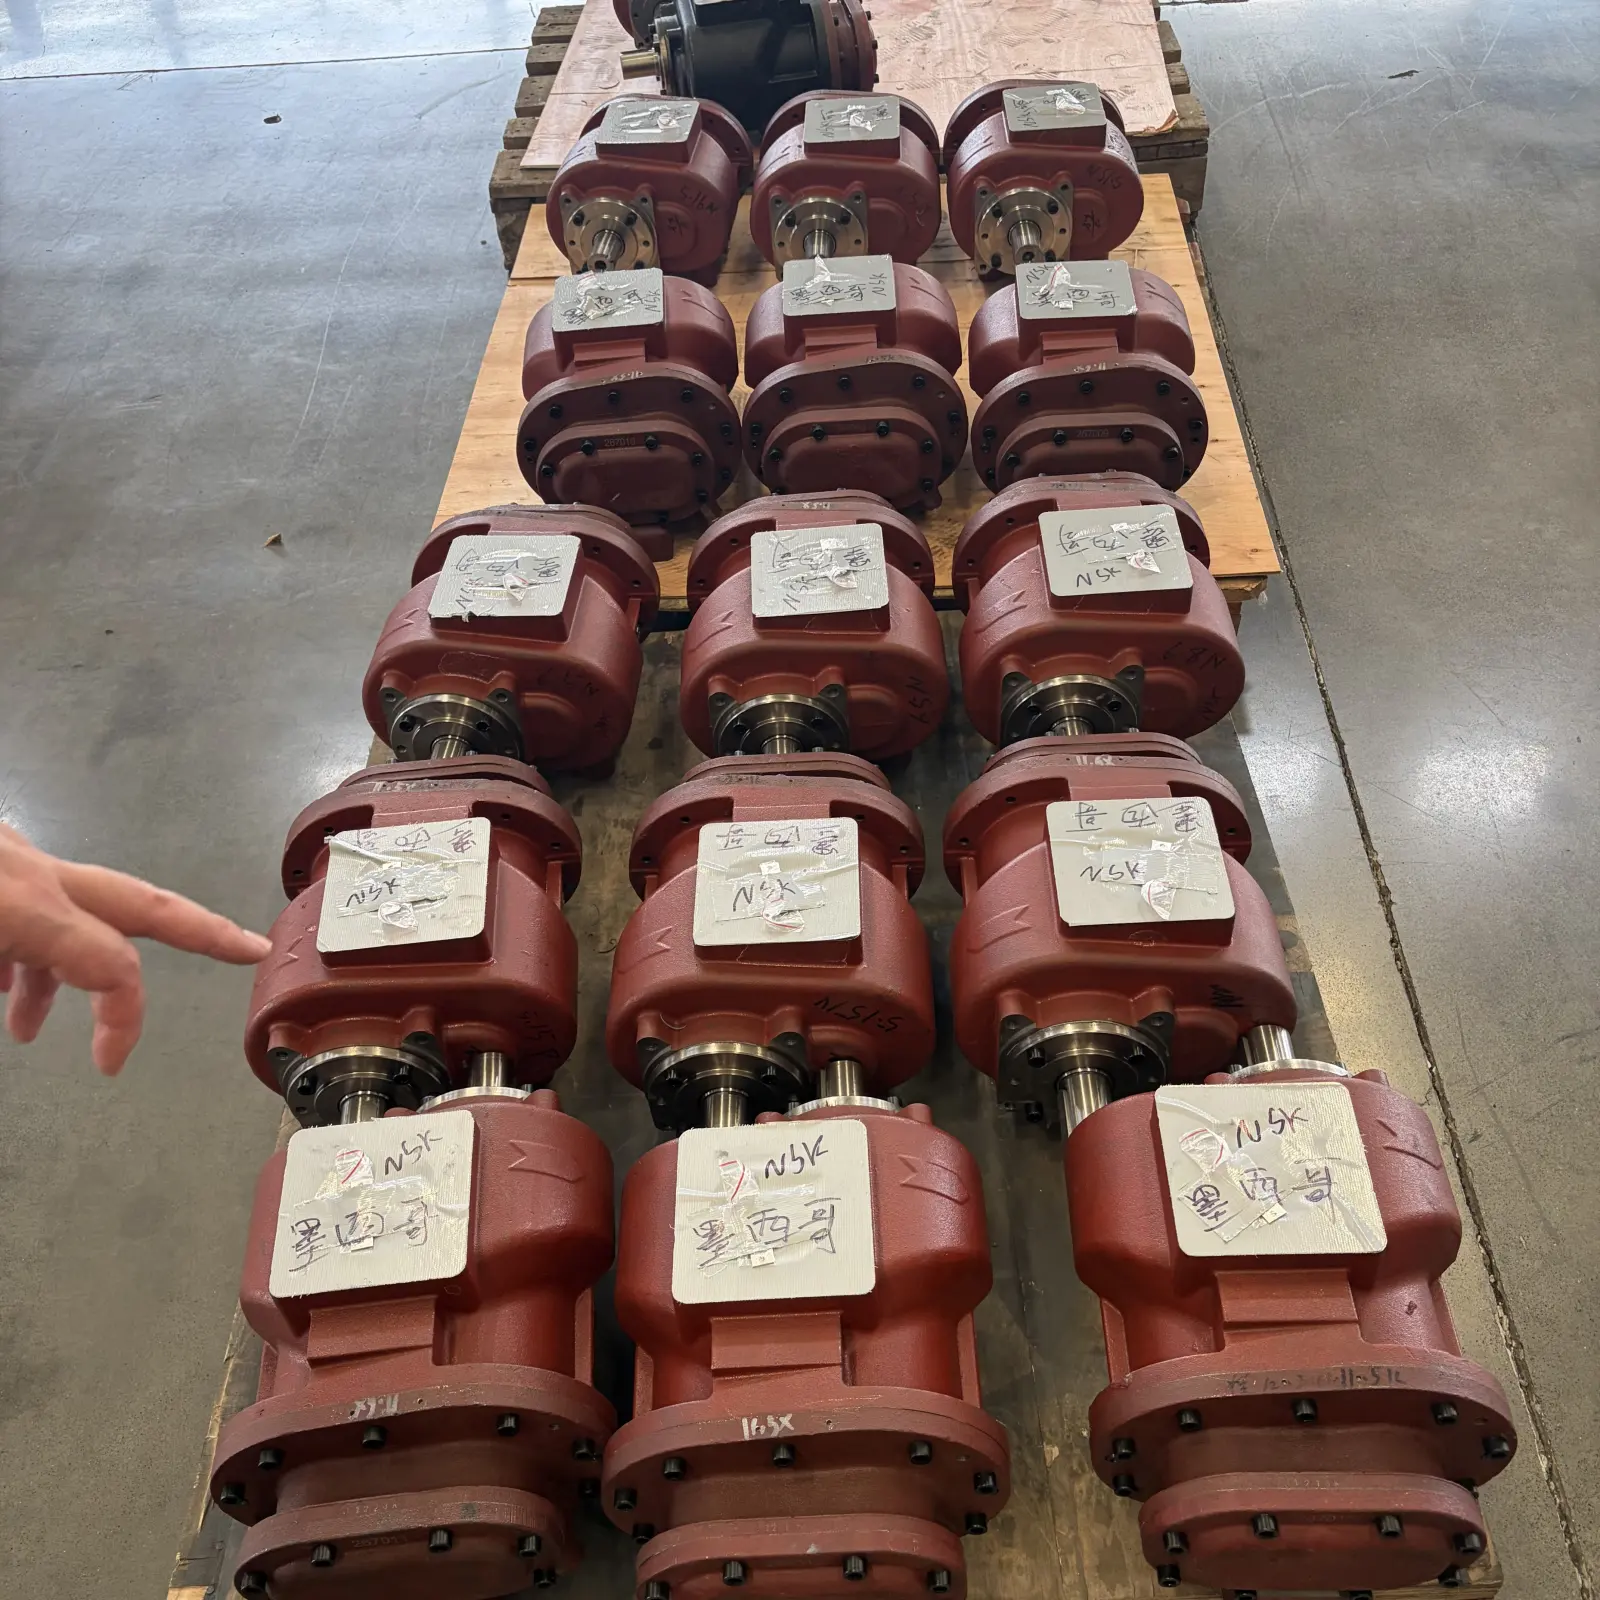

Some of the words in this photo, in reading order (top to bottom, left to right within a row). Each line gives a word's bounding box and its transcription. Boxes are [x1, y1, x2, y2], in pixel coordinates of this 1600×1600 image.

[868, 272, 887, 297] NSK
[1025, 264, 1056, 283] NSK
[645, 288, 662, 313] NSK
[1056, 520, 1170, 557] 墨西哥
[1076, 566, 1122, 588] NSK
[1079, 860, 1143, 882] NSK
[345, 877, 401, 908] NSK
[732, 878, 796, 912] NSK
[1236, 1107, 1309, 1149] NSK
[384, 1129, 443, 1176] NSK
[764, 1134, 829, 1179] NSK
[1183, 1156, 1344, 1234] 墨西哥
[288, 1195, 440, 1273] 墨西哥
[692, 1196, 842, 1270] 墨西哥
